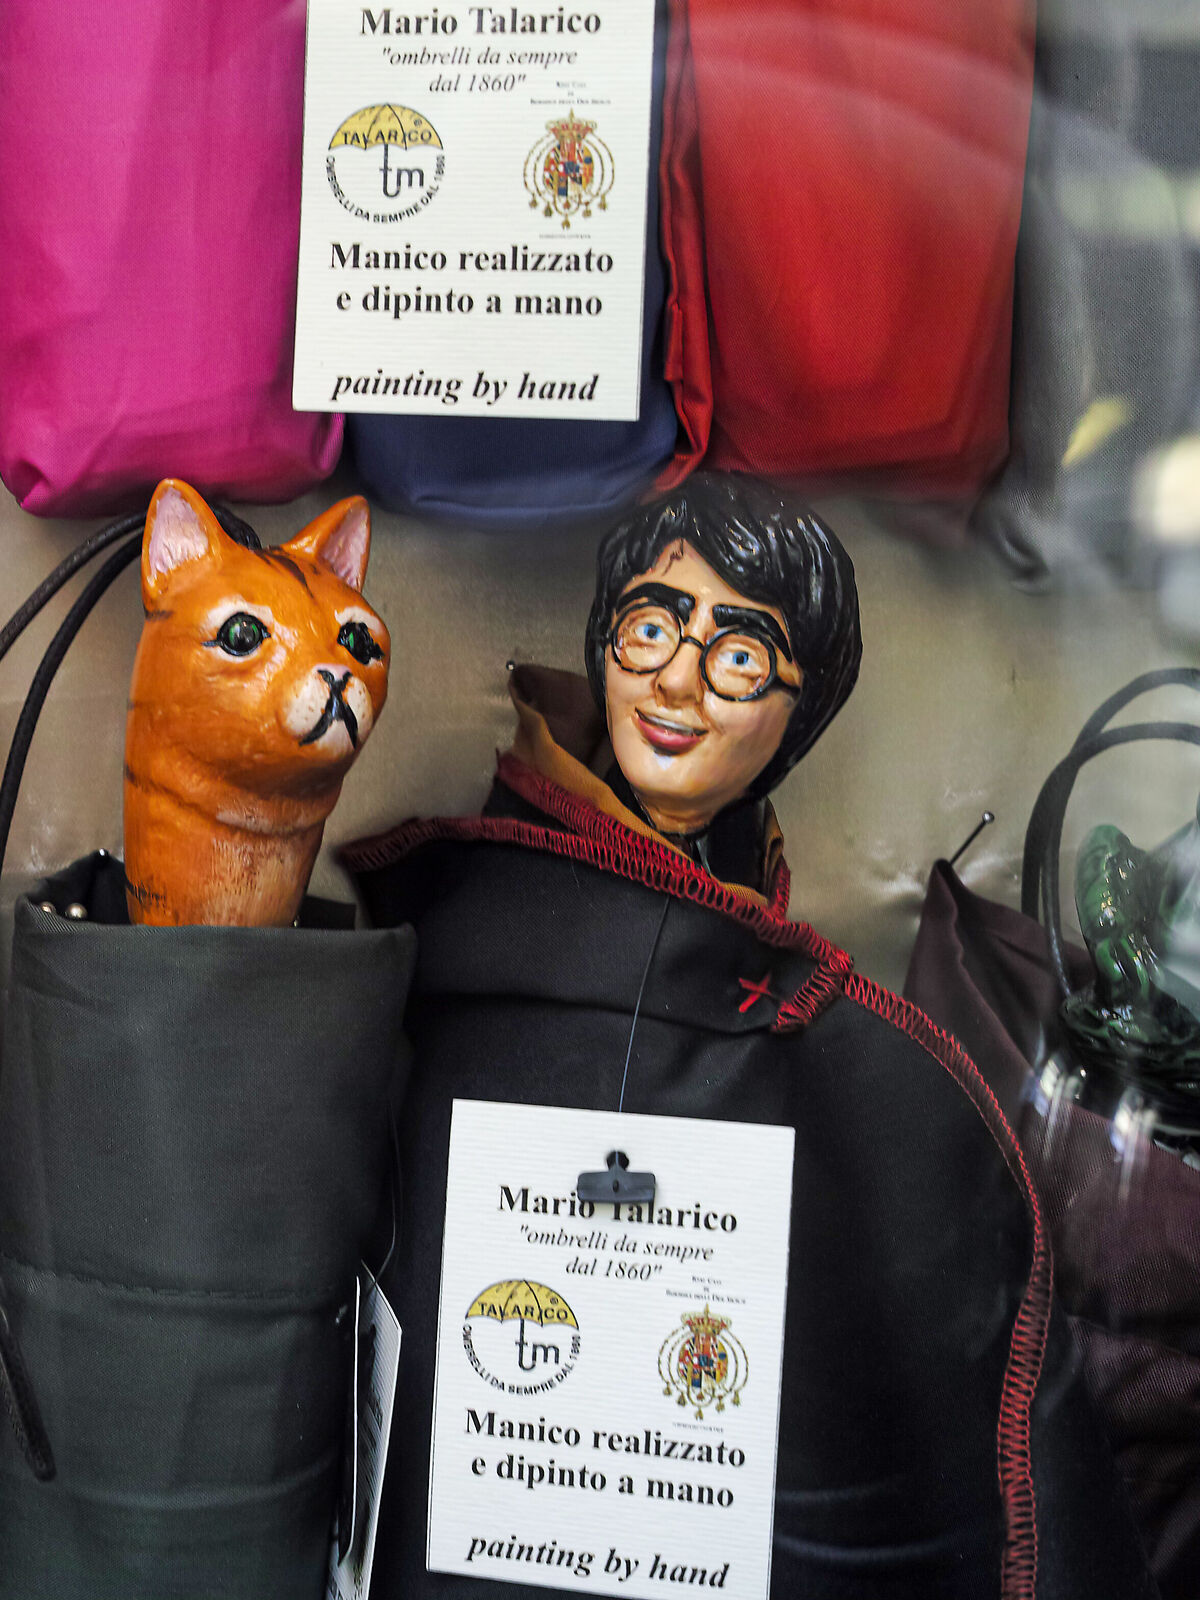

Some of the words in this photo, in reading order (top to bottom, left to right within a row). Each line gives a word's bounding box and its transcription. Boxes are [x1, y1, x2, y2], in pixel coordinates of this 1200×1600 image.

[360, 7, 458, 35] Mario
[468, 7, 601, 34] Talarico
[382, 46, 471, 66] "ombrelli
[477, 46, 501, 65] da
[507, 50, 578, 69] sempre
[429, 74, 460, 93] dal
[467, 74, 527, 92] 1860"
[420, 185, 439, 206] DAL
[329, 242, 447, 271] Manico
[458, 245, 614, 274] realizzato
[336, 290, 351, 311] e
[362, 285, 474, 319] dipinto
[486, 293, 503, 313] a
[515, 294, 603, 317] mano
[330, 368, 463, 405] painting
[472, 370, 508, 405] by
[517, 372, 600, 401] hand
[497, 1185, 595, 1219] Mario
[520, 1224, 608, 1250] "ombrelli
[614, 1234, 637, 1254] da
[643, 1243, 714, 1263] sempre
[565, 1256, 597, 1276] dal
[604, 1260, 663, 1281] 1860"
[555, 1362, 574, 1383] DAL
[464, 1408, 581, 1447] Manico
[592, 1430, 745, 1468] realizzato
[471, 1455, 486, 1476] e
[496, 1454, 607, 1491] dipinto
[618, 1473, 634, 1495] a
[647, 1478, 734, 1508] mano
[465, 1535, 595, 1577] painting
[604, 1548, 640, 1583] by
[649, 1554, 730, 1589] hand
